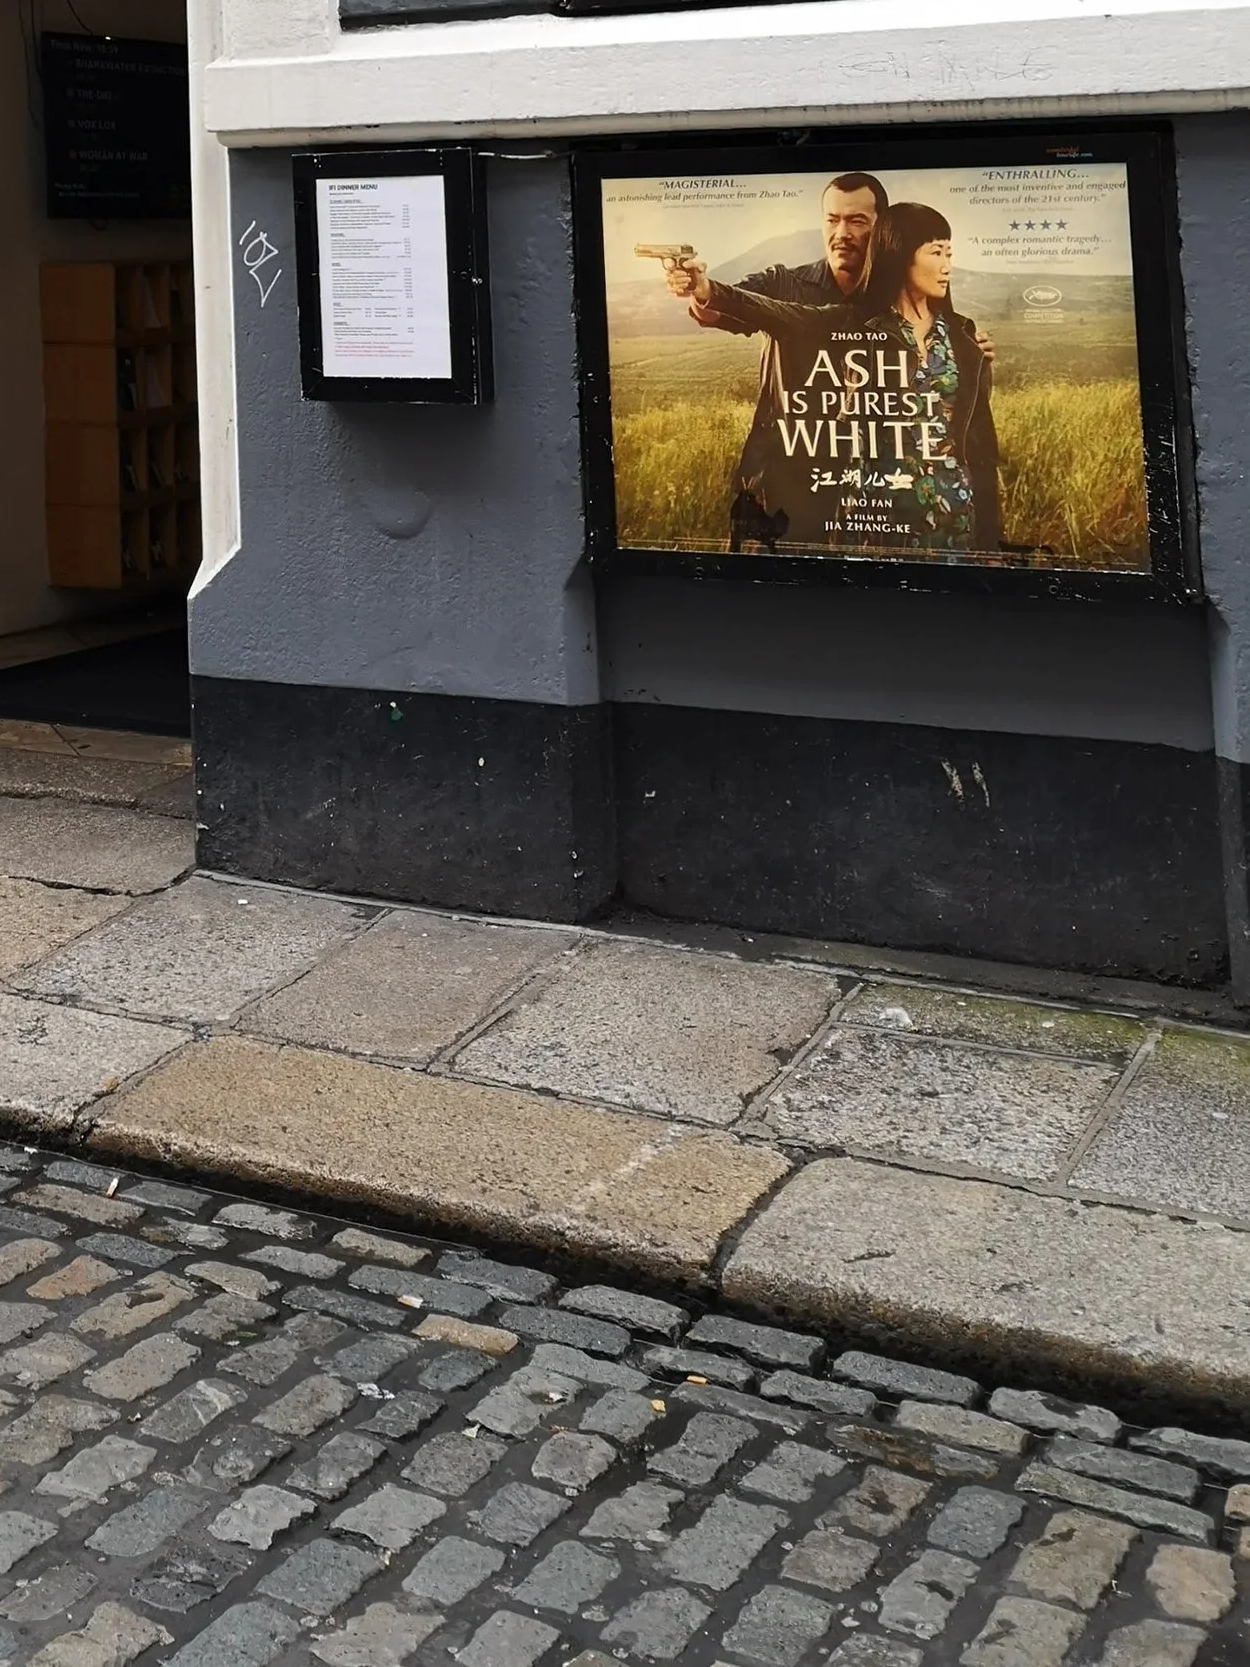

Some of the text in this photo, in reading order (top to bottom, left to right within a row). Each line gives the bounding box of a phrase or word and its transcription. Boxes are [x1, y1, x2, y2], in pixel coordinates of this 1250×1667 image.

[969, 184, 979, 193] of
[980, 184, 995, 192] the
[997, 184, 1020, 192] most
[1022, 182, 1064, 191] inventive
[1066, 182, 1084, 190] and
[1085, 181, 1126, 192] engaged
[618, 192, 663, 203] astonishing
[664, 192, 681, 201] lead
[683, 191, 735, 202] performance
[736, 190, 757, 199] from
[759, 190, 780, 199] Zhao
[969, 196, 1010, 205] directors
[1011, 195, 1022, 204] of
[1024, 195, 1039, 204] the
[981, 236, 1020, 246] complex
[1022, 234, 1064, 244] romantic
[995, 247, 1019, 256] often
[1020, 247, 1060, 258] glorious
[831, 332, 888, 341] ZHAO TAO
[804, 350, 909, 388] ASH
[783, 390, 941, 417] IS PUREST
[777, 419, 948, 461] WHITE
[841, 497, 893, 508] LIAO FAN
[825, 521, 911, 534] JIA ZHANG-KE
